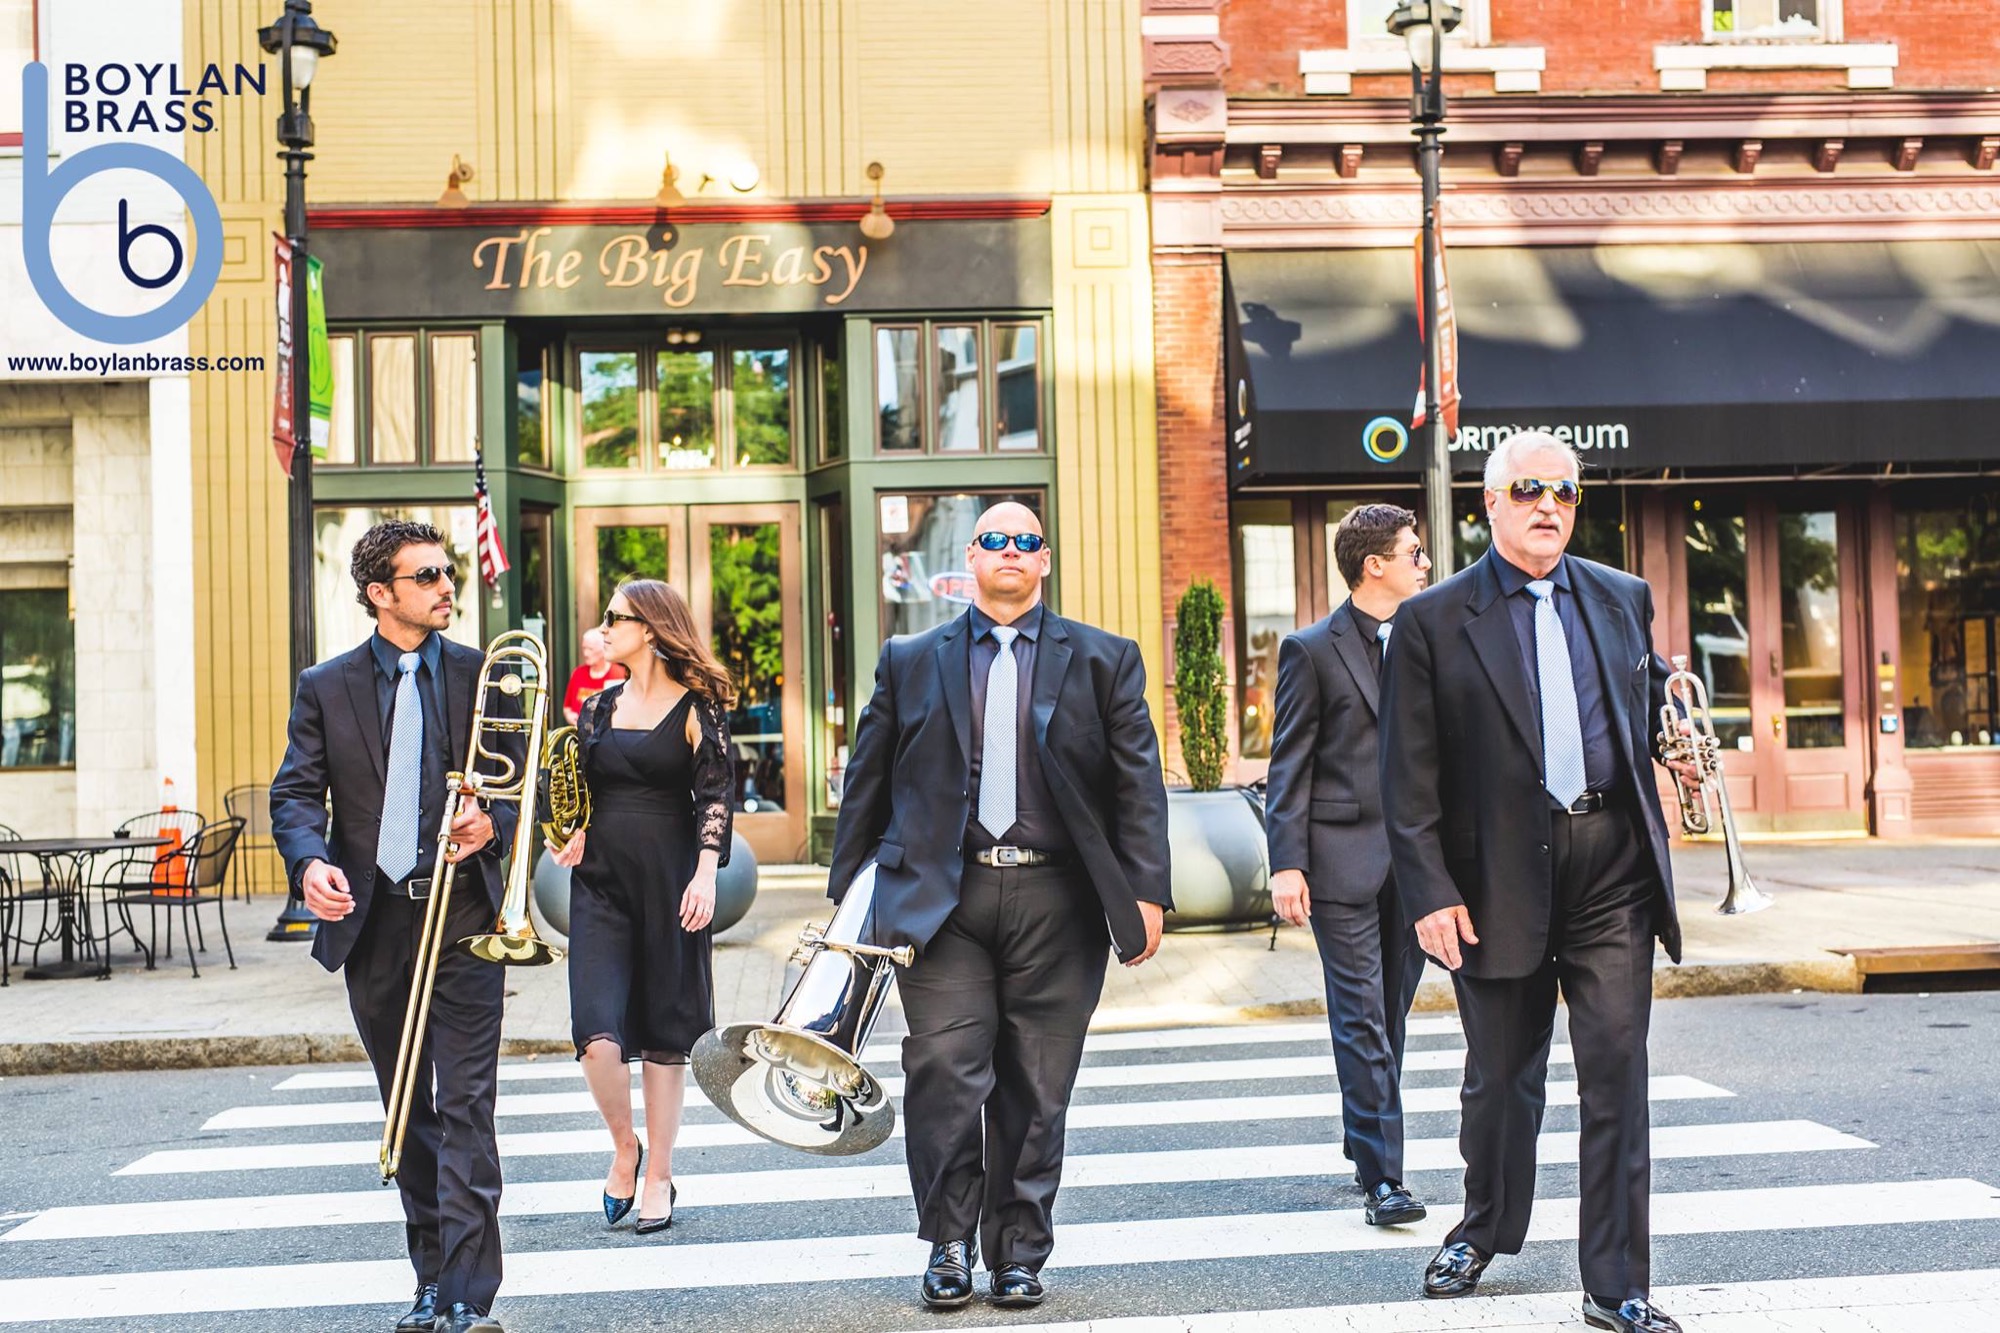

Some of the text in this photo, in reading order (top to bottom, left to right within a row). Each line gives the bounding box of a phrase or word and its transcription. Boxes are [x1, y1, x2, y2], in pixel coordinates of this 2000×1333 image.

[473, 227, 868, 308] The Big Easy
[933, 577, 976, 598] OPE
